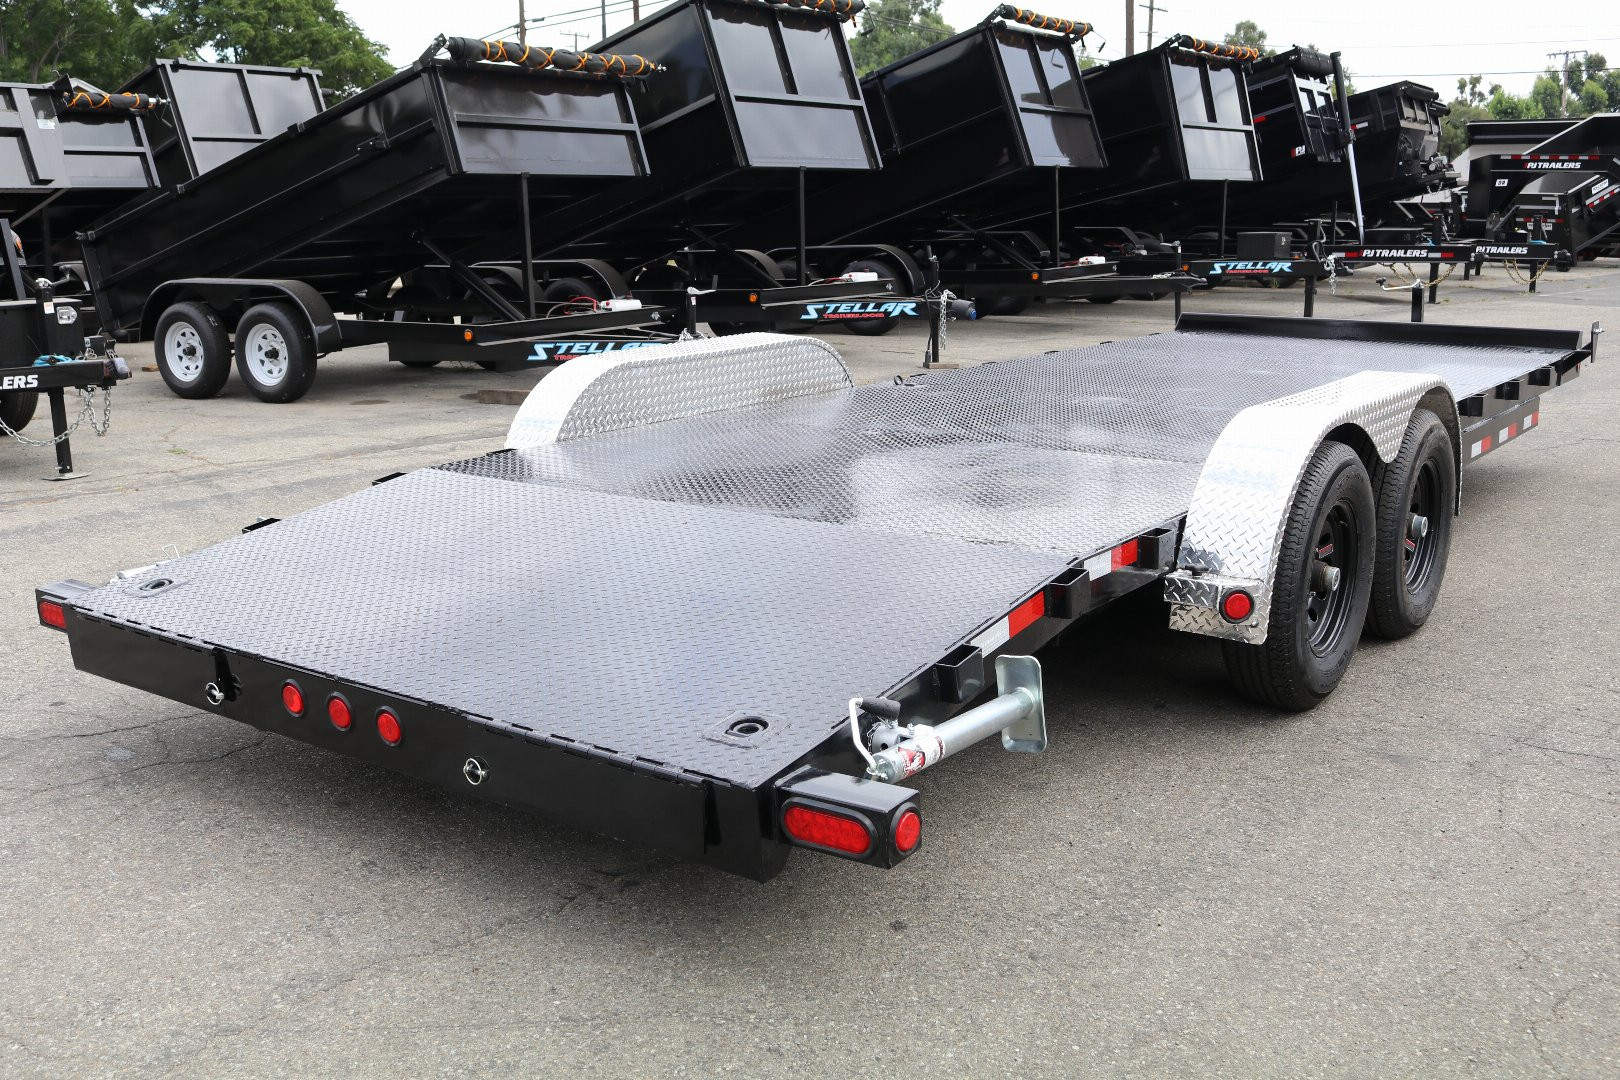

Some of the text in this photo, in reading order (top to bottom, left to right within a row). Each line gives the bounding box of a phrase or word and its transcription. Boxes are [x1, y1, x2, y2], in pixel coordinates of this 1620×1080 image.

[1362, 249, 1428, 258] PJ TRAILERS
[1485, 246, 1529, 255] TRAILERS
[1208, 261, 1294, 275] STELLAR
[799, 302, 920, 320] STELLAR
[526, 342, 665, 361] STELLA
[0, 374, 39, 390] ERS
